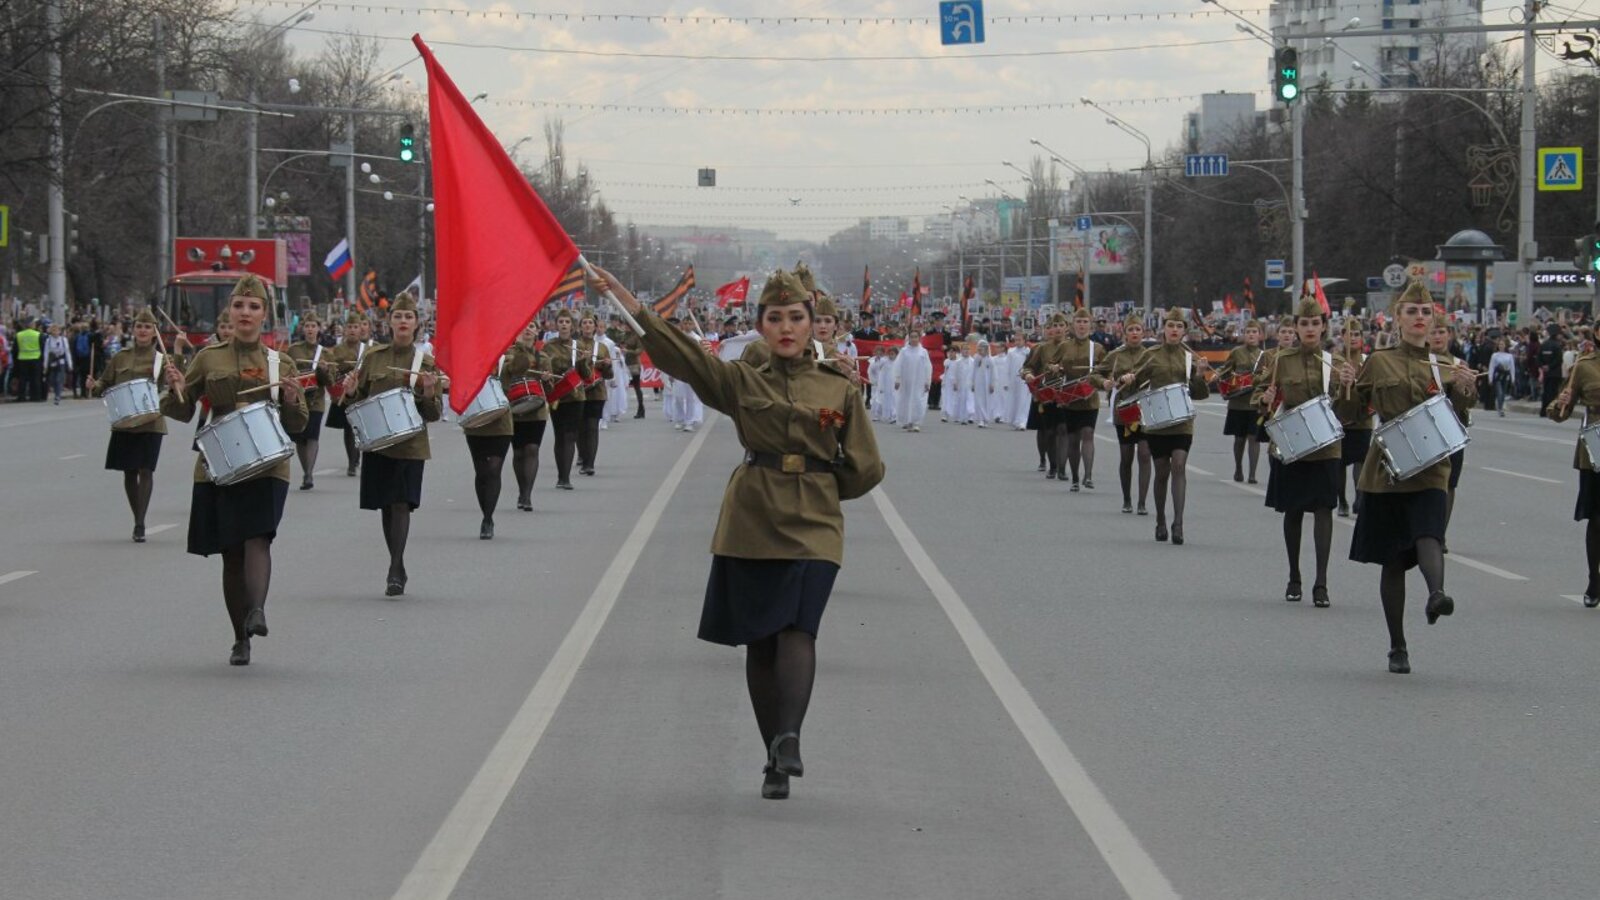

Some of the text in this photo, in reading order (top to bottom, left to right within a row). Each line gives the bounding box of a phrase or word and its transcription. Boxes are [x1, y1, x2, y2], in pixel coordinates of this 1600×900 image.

[1282, 69, 1296, 79] 44
[1412, 266, 1424, 276] 24
[1390, 273, 1401, 281] 24
